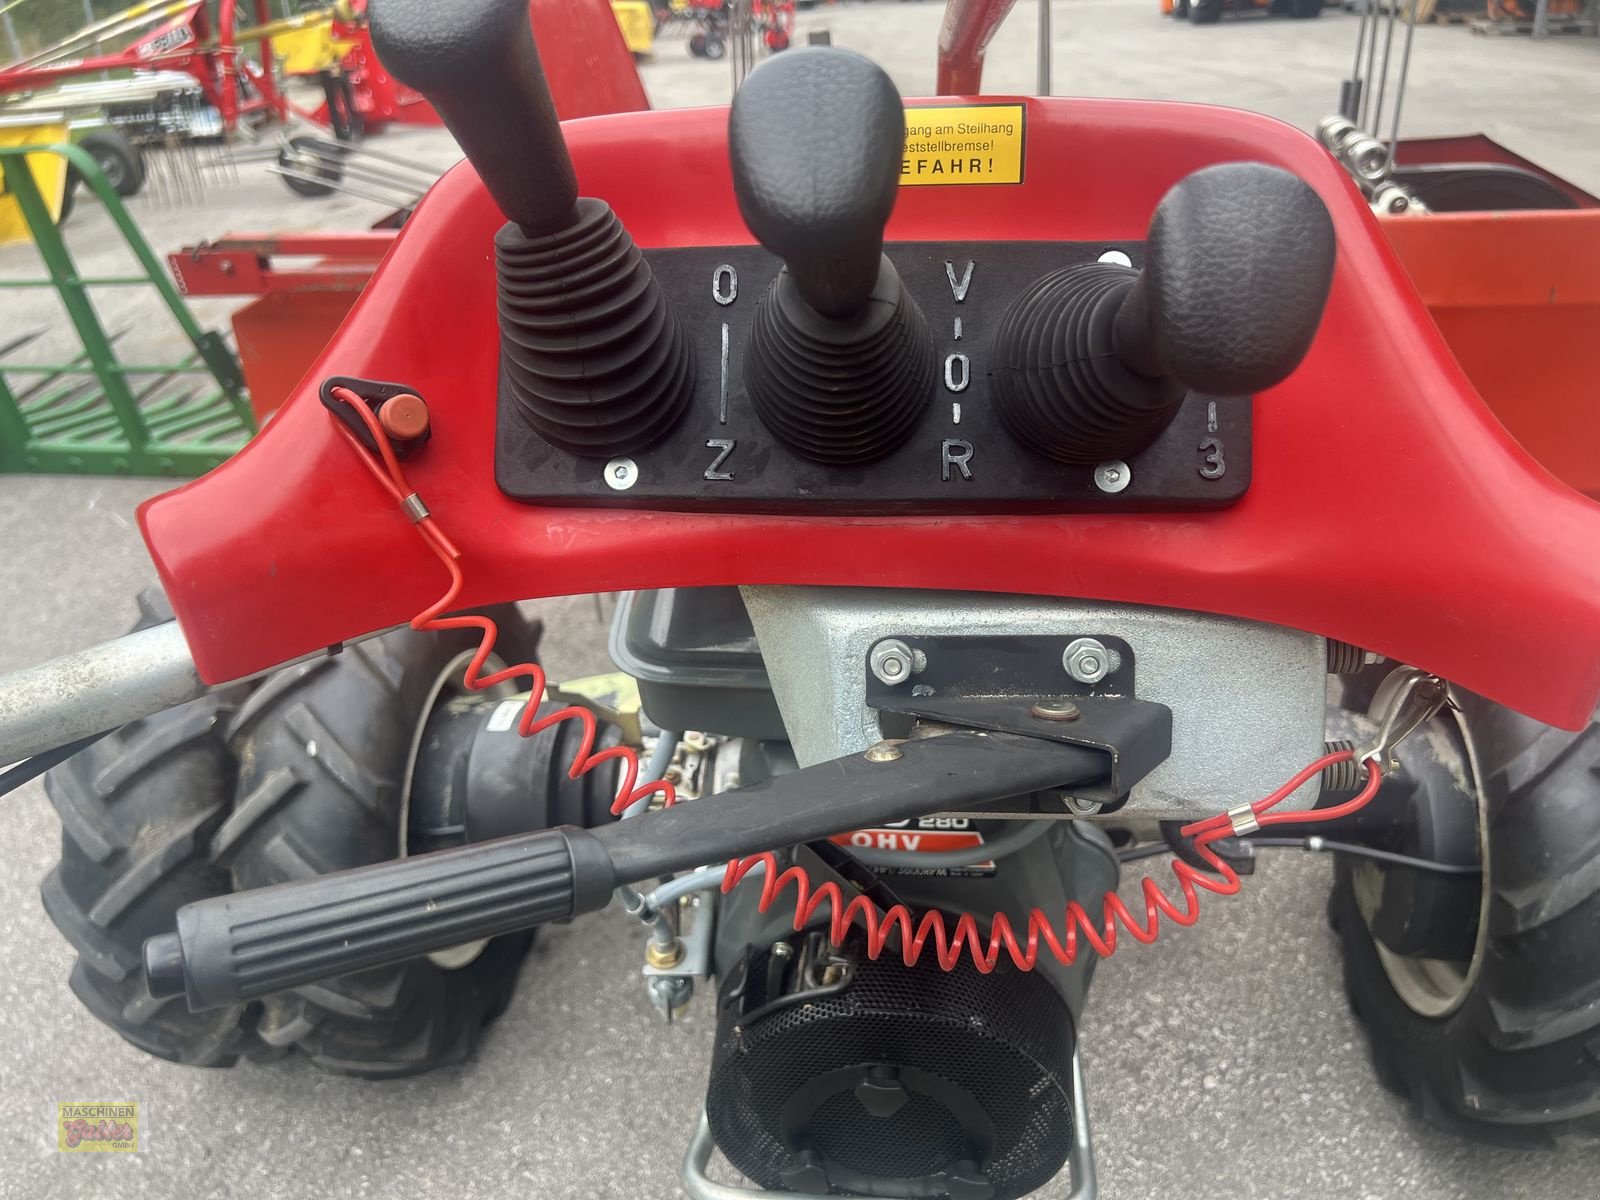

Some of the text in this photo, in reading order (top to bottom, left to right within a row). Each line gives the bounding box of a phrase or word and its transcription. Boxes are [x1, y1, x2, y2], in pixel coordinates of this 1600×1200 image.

[904, 122, 1013, 138] gang am Steilhang
[903, 140, 994, 153] eststellbremse!
[901, 158, 993, 174] EFAHR!
[945, 260, 976, 303] V
[703, 439, 736, 480] Z
[941, 439, 974, 481] R
[1199, 438, 1225, 479] 3
[851, 832, 921, 851] OHV
